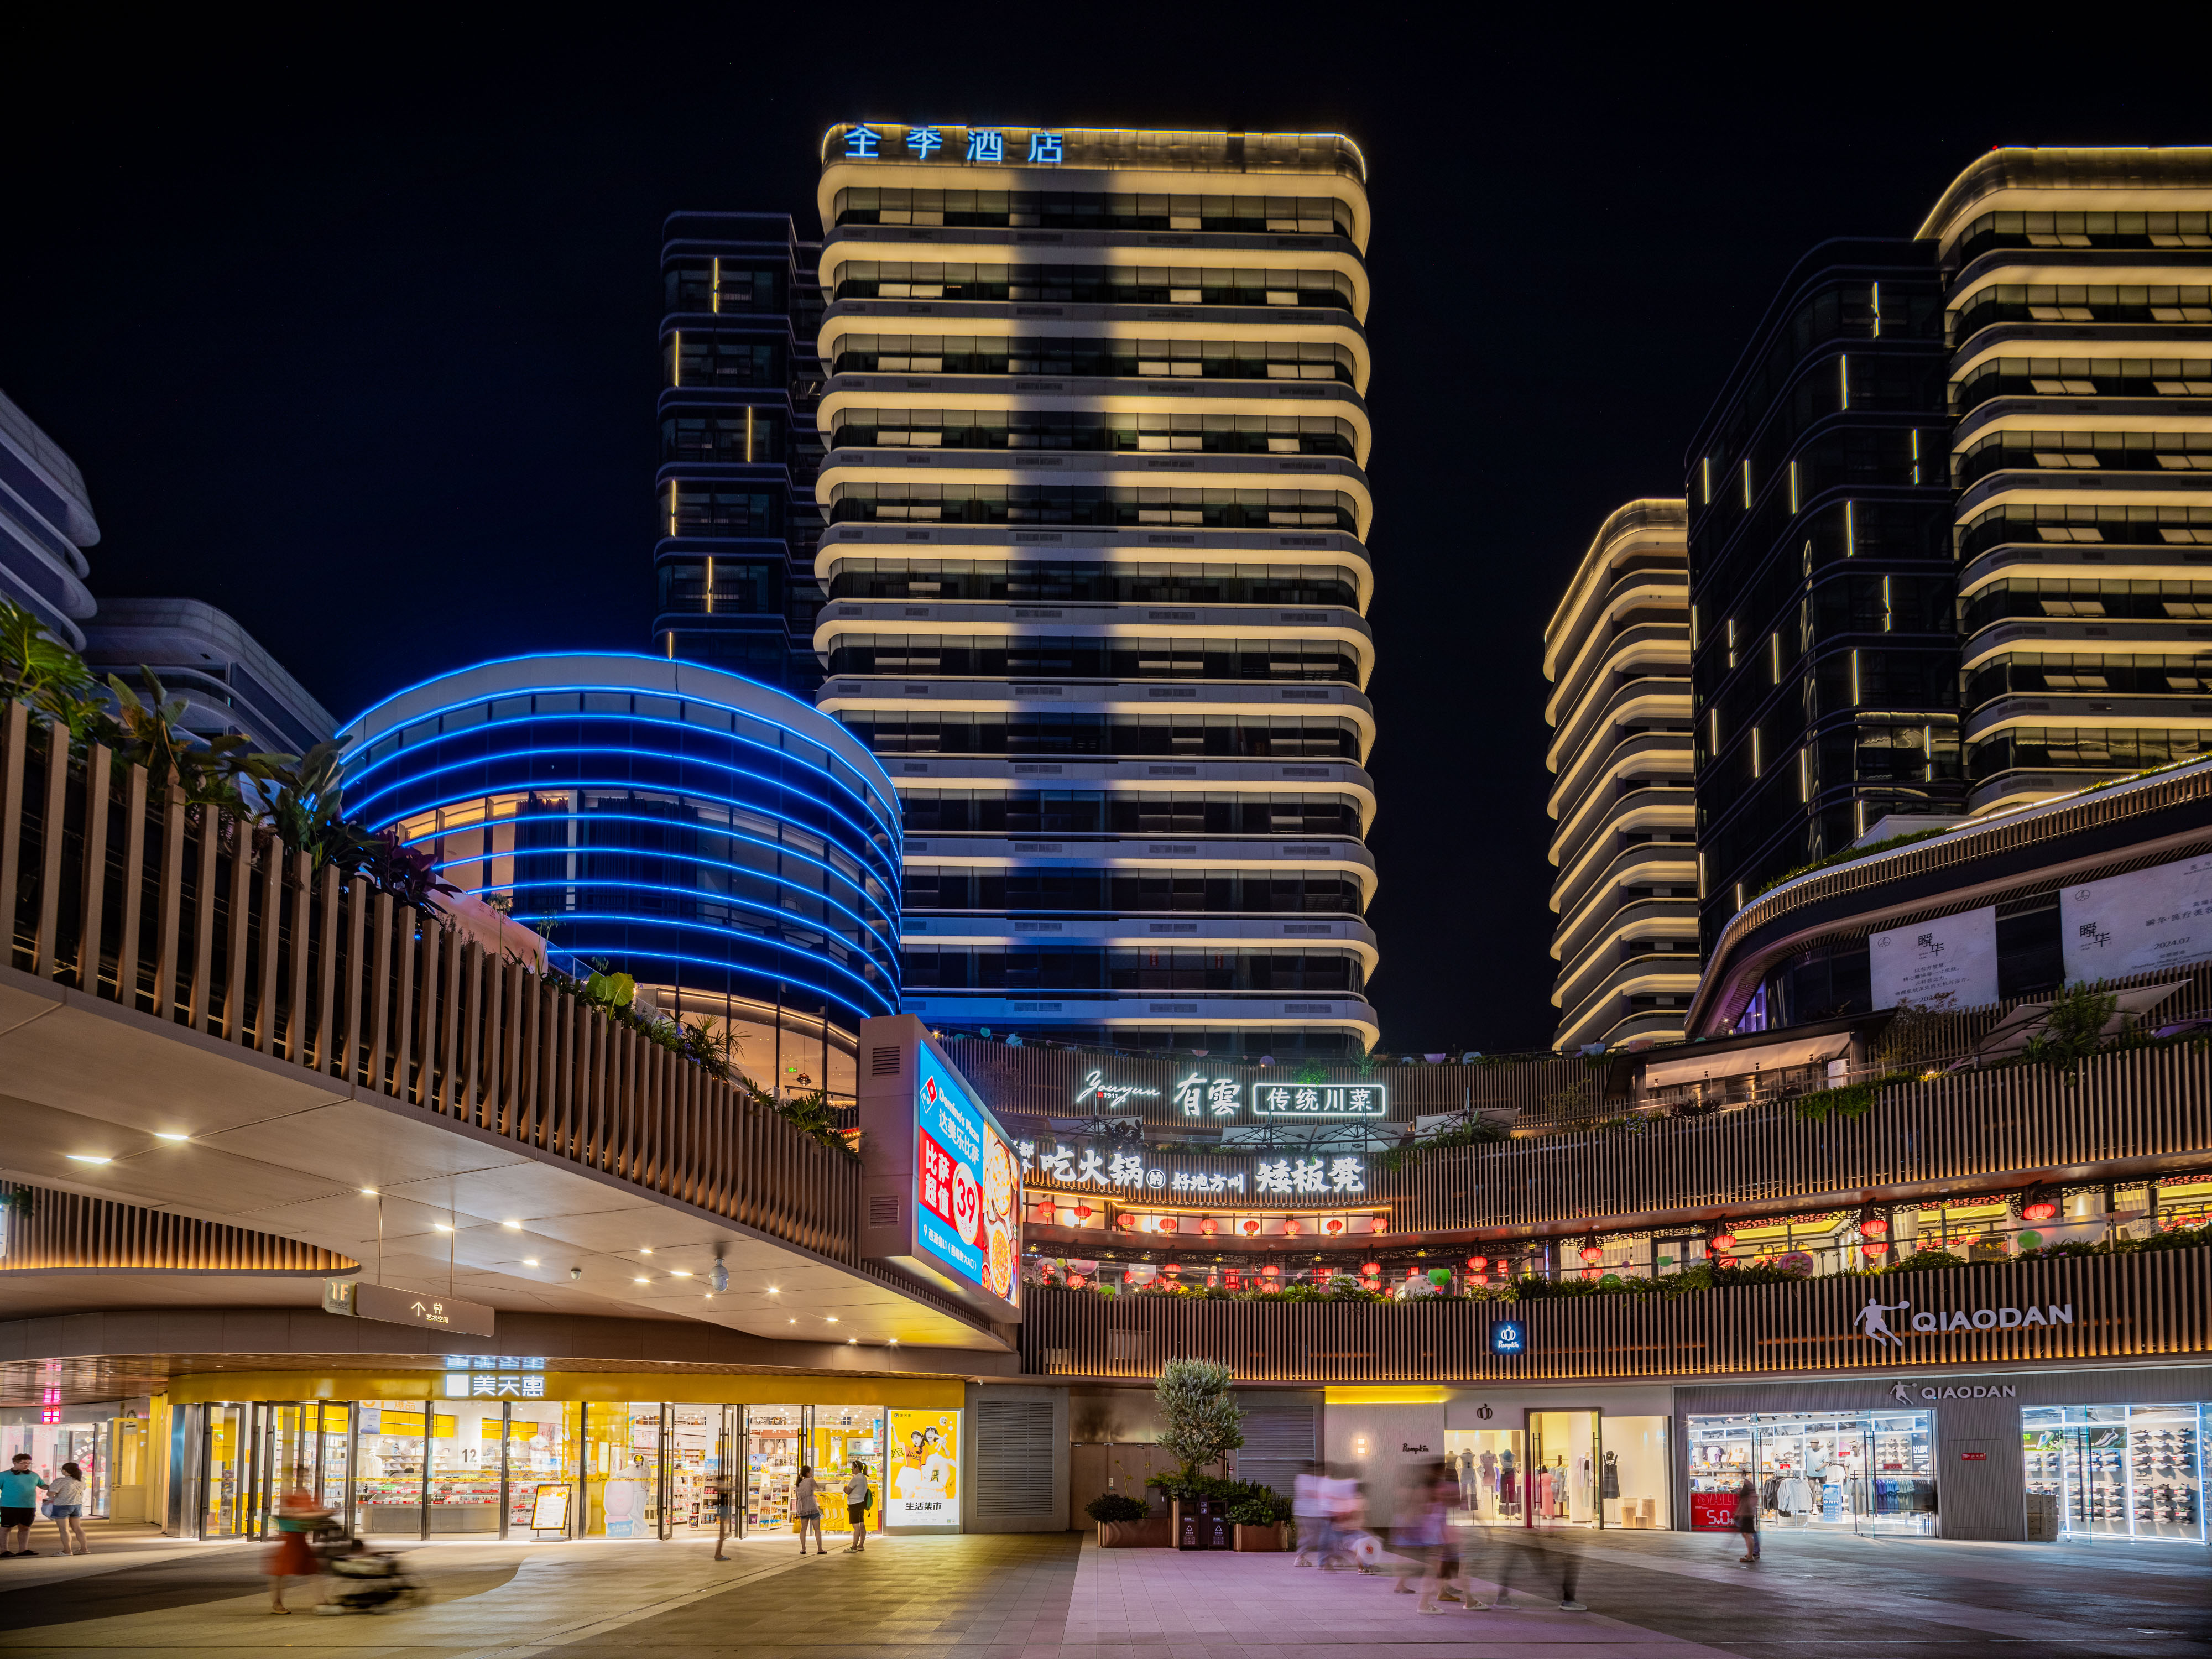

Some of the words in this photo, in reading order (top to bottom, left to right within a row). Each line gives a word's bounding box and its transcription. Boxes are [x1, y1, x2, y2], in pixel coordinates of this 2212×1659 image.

[844, 125, 1062, 163] 全季酒店
[1918, 932, 1944, 957] 瞬华
[2080, 922, 2111, 947] 瞬华
[2154, 937, 2190, 950] 2024.07
[1266, 1087, 1372, 1112] 传统川菜
[939, 1108, 979, 1165] 达美乐比萨
[926, 1139, 950, 1183] 比萨
[1040, 1145, 1144, 1189] 吃火锅
[1171, 1172, 1244, 1193] 好地方叫
[925, 1172, 950, 1218] 超值
[957, 1178, 975, 1223] 39
[332, 1282, 348, 1301] 1F
[426, 1313, 449, 1324] 艺术空间
[1912, 1303, 2073, 1332] QIAODAN
[1498, 1340, 1519, 1350] Pumpkin
[473, 1375, 545, 1397] 美天惠
[1922, 1385, 2016, 1400] QIAODAN
[462, 1448, 477, 1463] 12
[1402, 1443, 1429, 1454] Pumpkin
[905, 1502, 942, 1510] 生活集市
